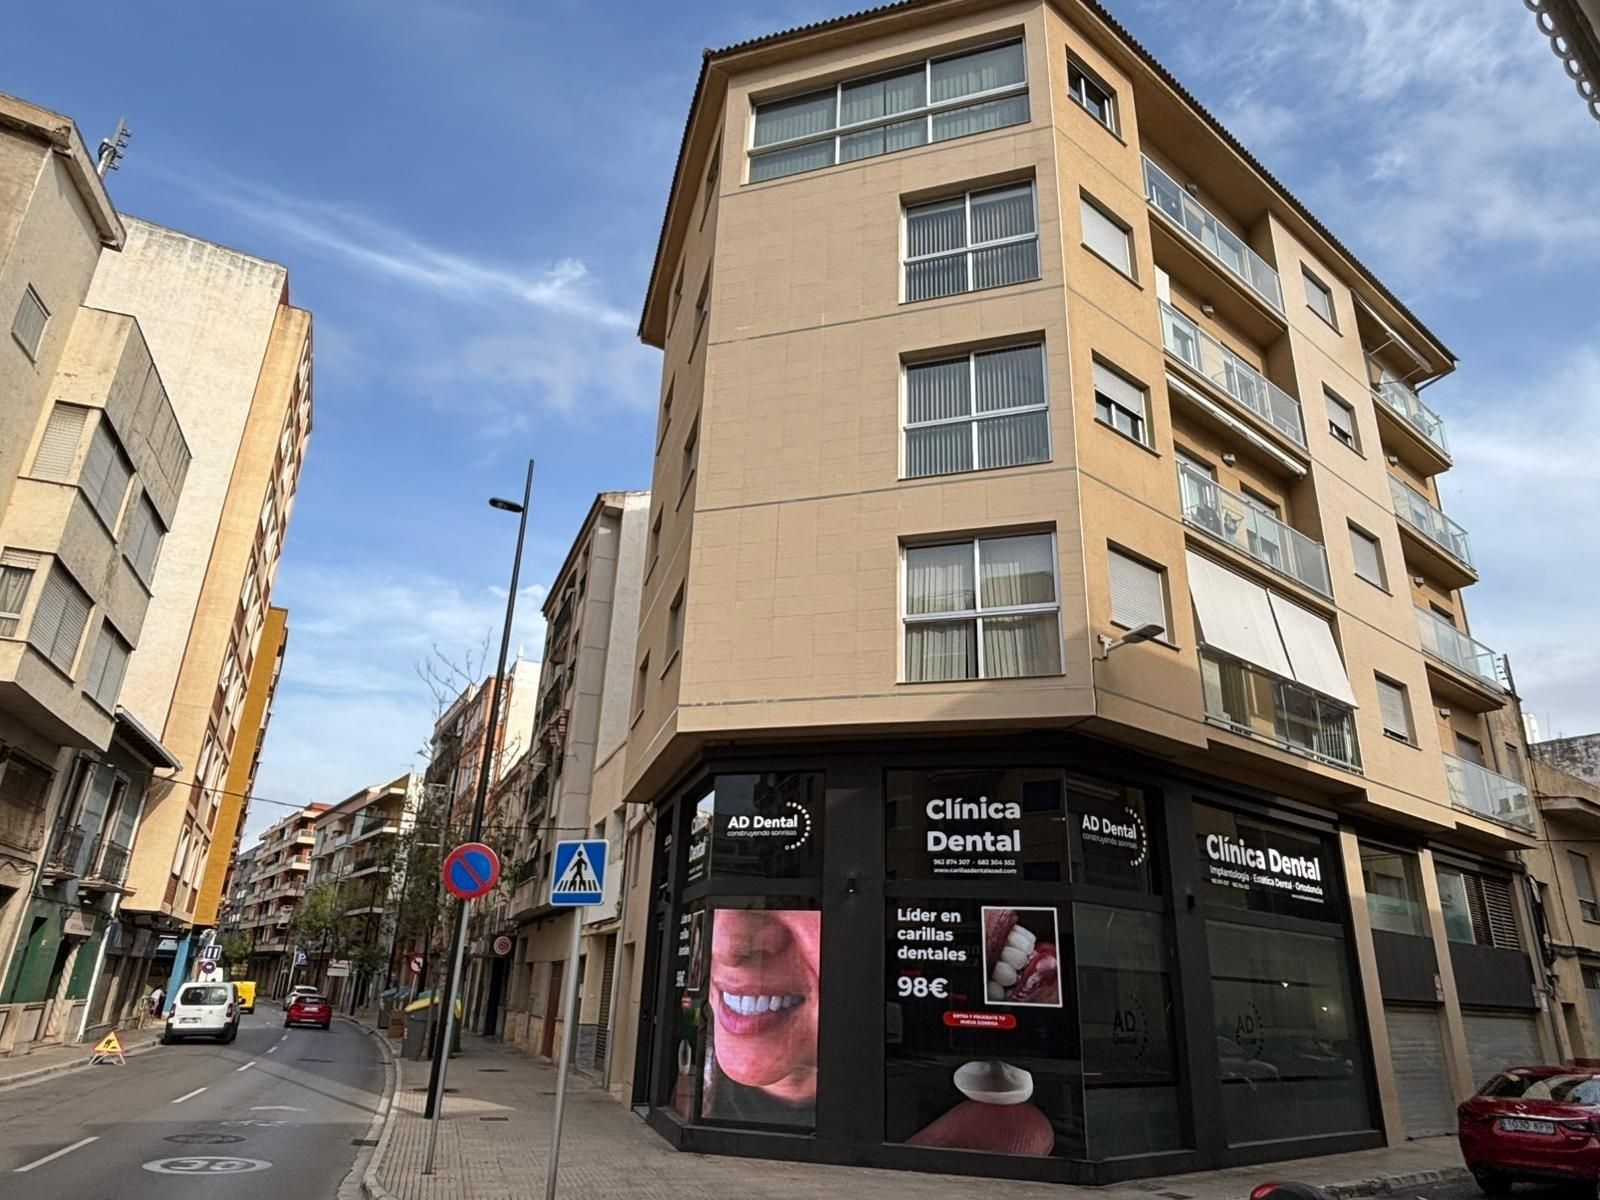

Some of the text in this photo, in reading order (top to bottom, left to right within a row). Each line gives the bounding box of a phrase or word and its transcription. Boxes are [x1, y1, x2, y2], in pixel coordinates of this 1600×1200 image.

[926, 796, 1021, 820] Clínica
[727, 814, 798, 829] AD Dental
[1082, 814, 1137, 840] AD Dental
[926, 829, 1021, 852] Dental
[1206, 834, 1321, 881] Clínica Dental
[1275, 878, 1293, 890] Dental
[897, 908, 961, 923] Líder en
[897, 926, 954, 941] carillas
[897, 945, 967, 961] dentales
[897, 976, 949, 998] 98€
[169, 1160, 247, 1171] 30
